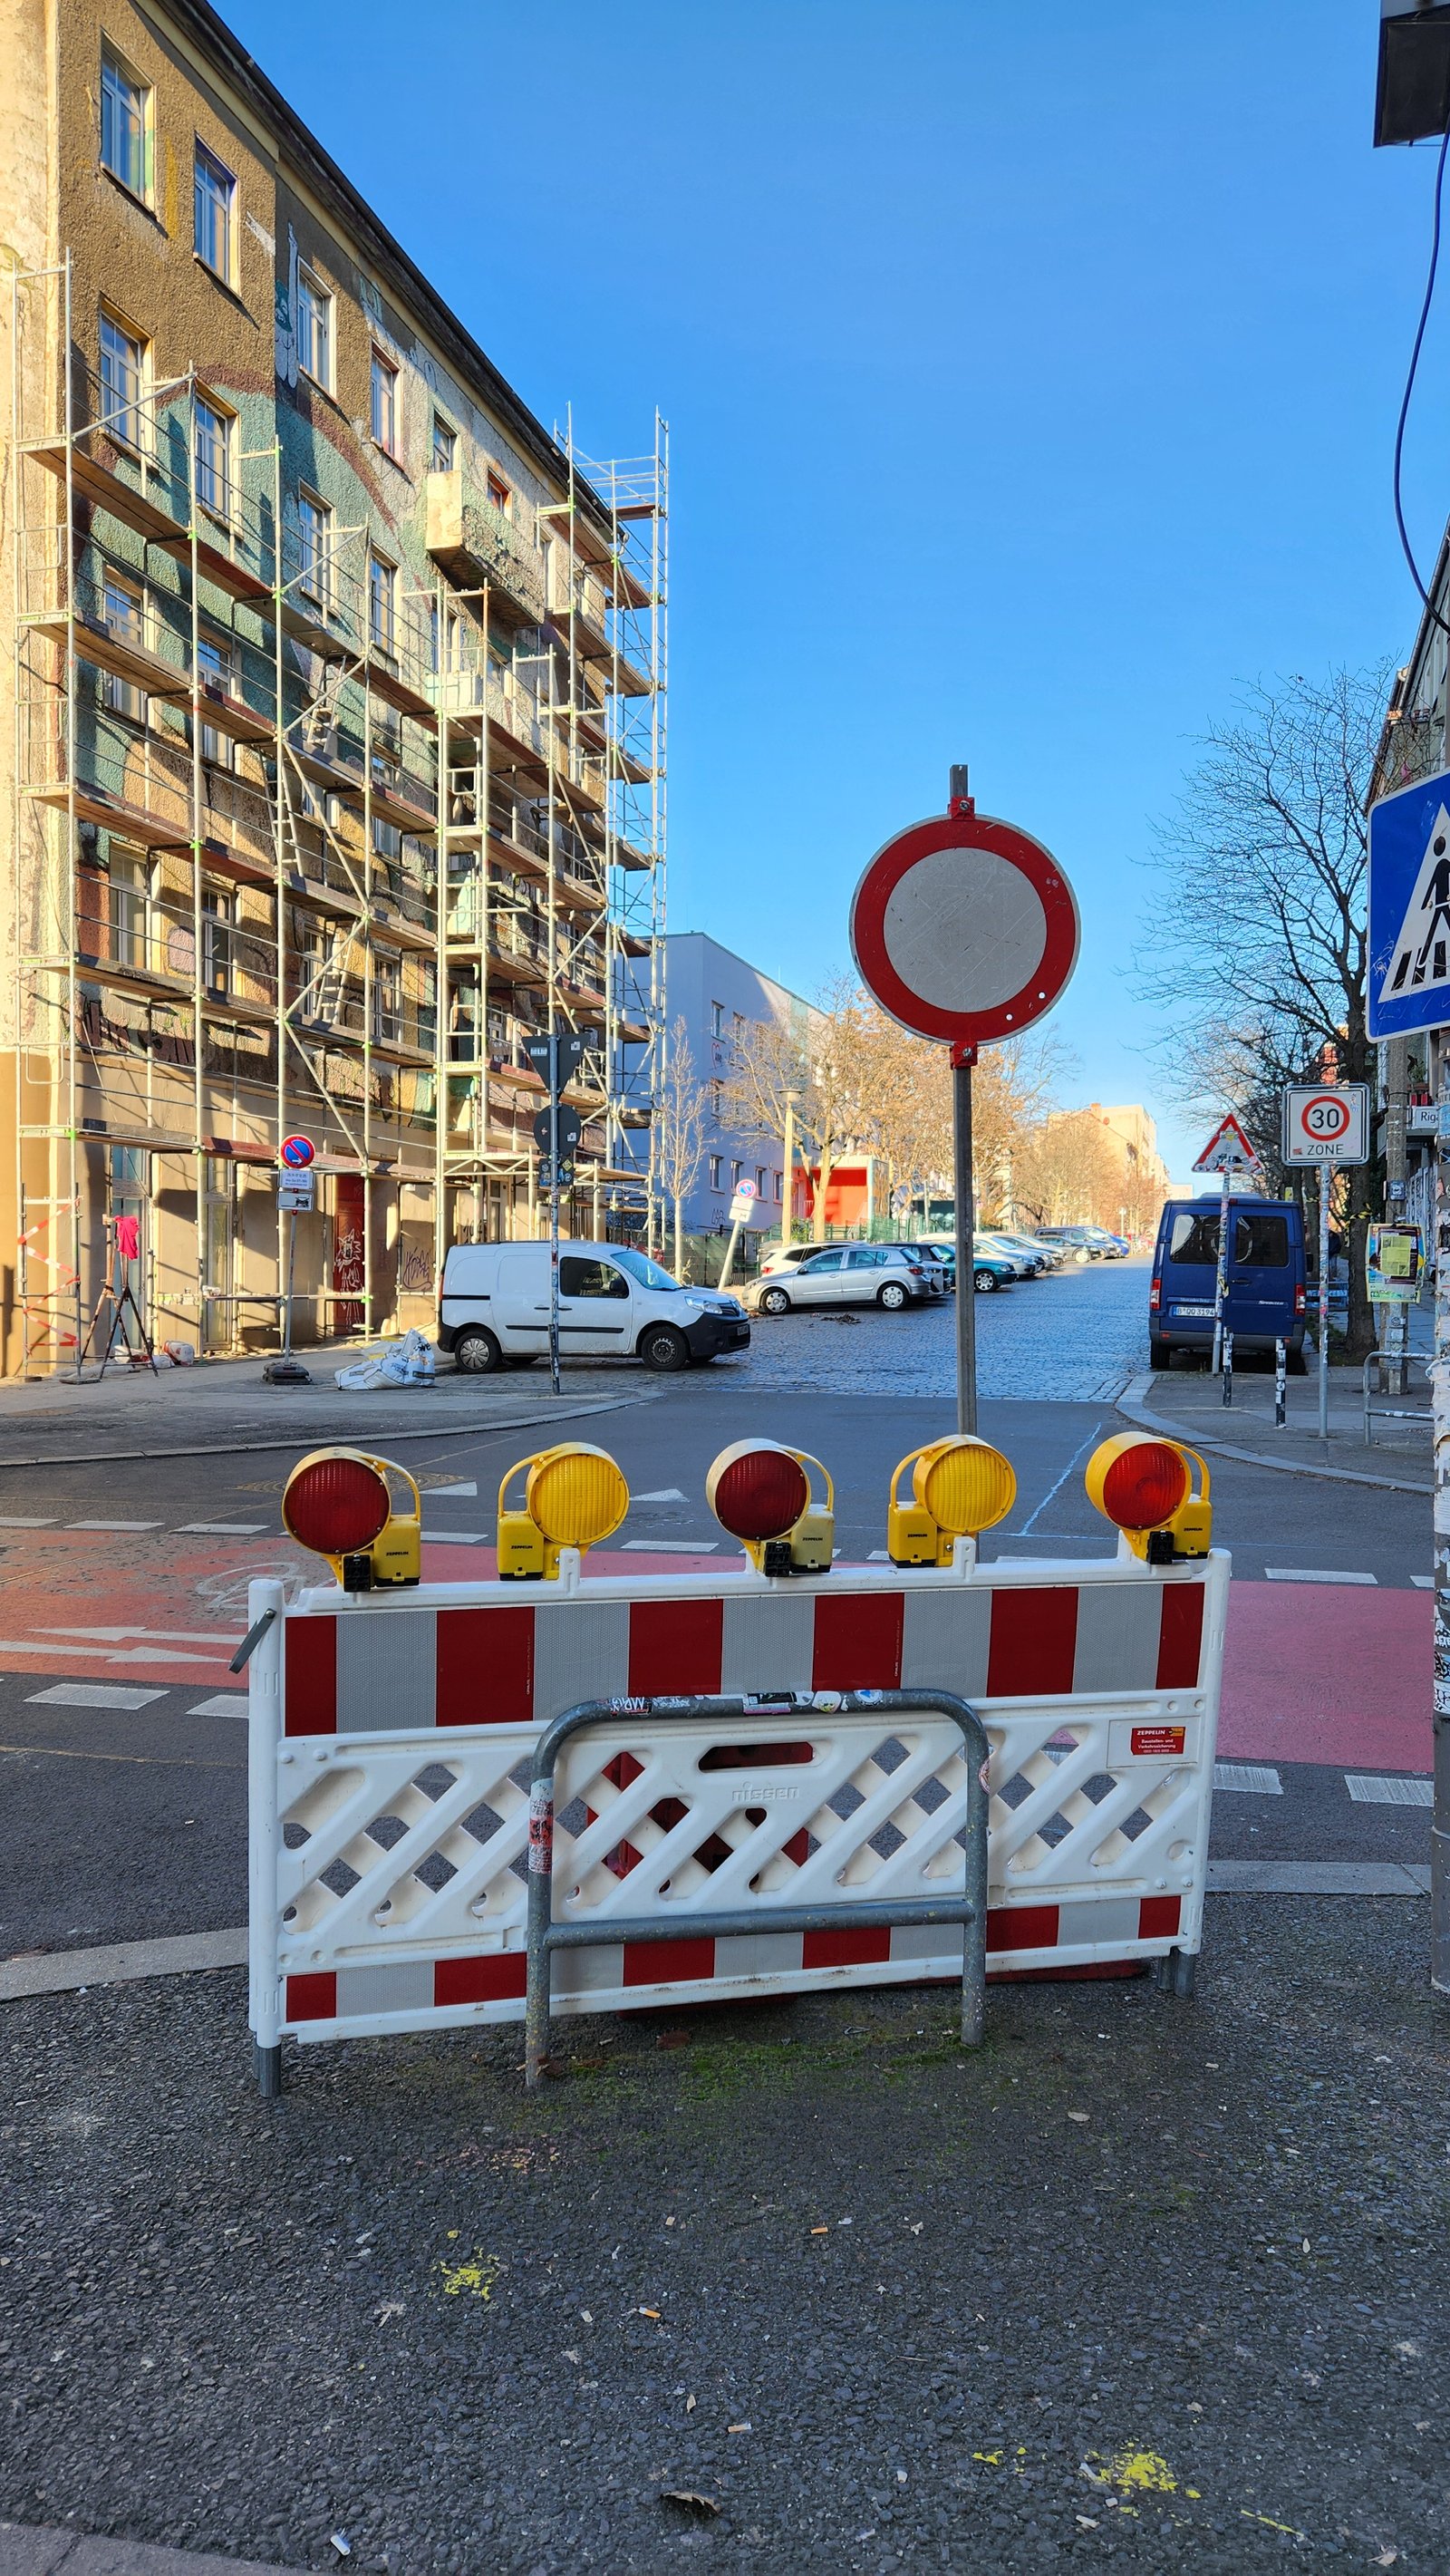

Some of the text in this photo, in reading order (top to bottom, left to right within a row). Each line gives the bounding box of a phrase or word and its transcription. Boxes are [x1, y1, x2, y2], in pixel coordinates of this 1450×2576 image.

[1311, 1109, 1339, 1128] 30
[1307, 1144, 1344, 1156] ZONE
[731, 1781, 798, 1802] nissen
